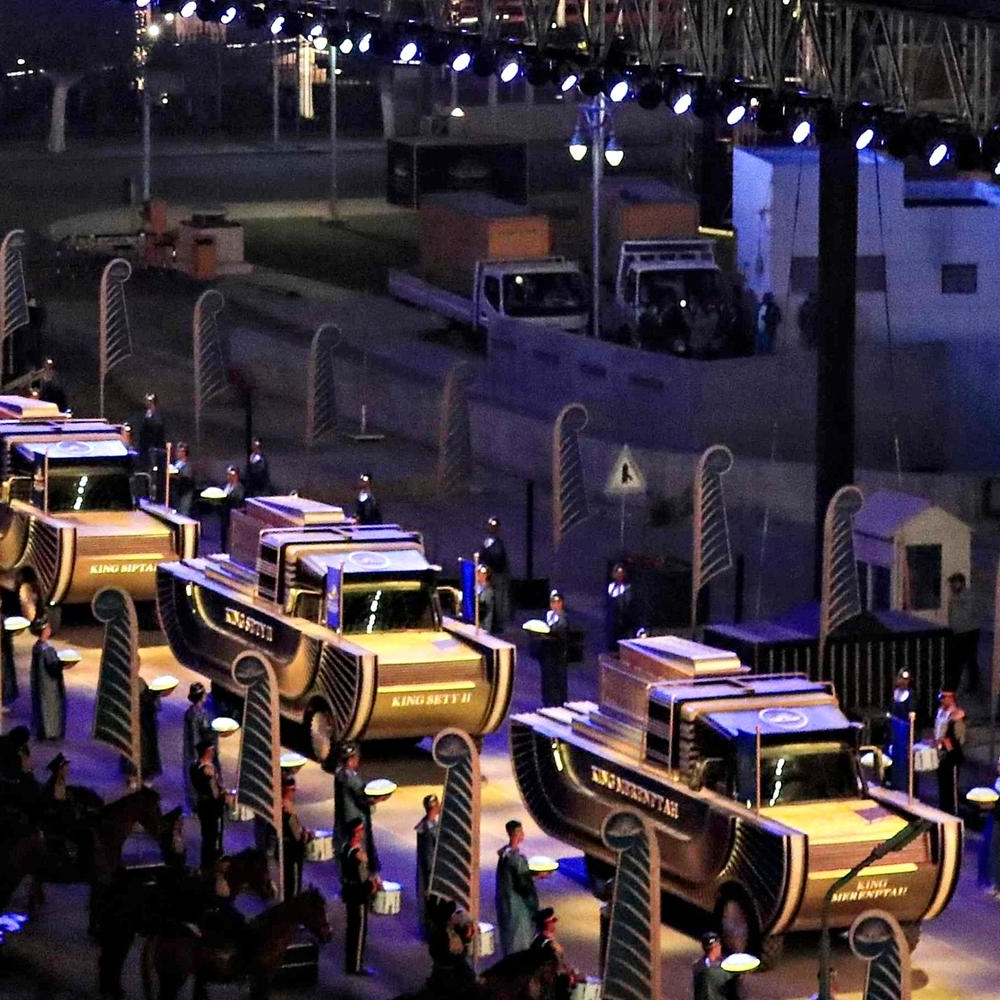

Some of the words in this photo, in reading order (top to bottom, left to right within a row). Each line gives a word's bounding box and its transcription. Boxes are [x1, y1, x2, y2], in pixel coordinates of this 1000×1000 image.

[89, 564, 120, 574] KING
[391, 694, 425, 707] KING
[425, 693, 459, 705] SETY
[460, 692, 472, 704] II
[856, 879, 889, 891] KING
